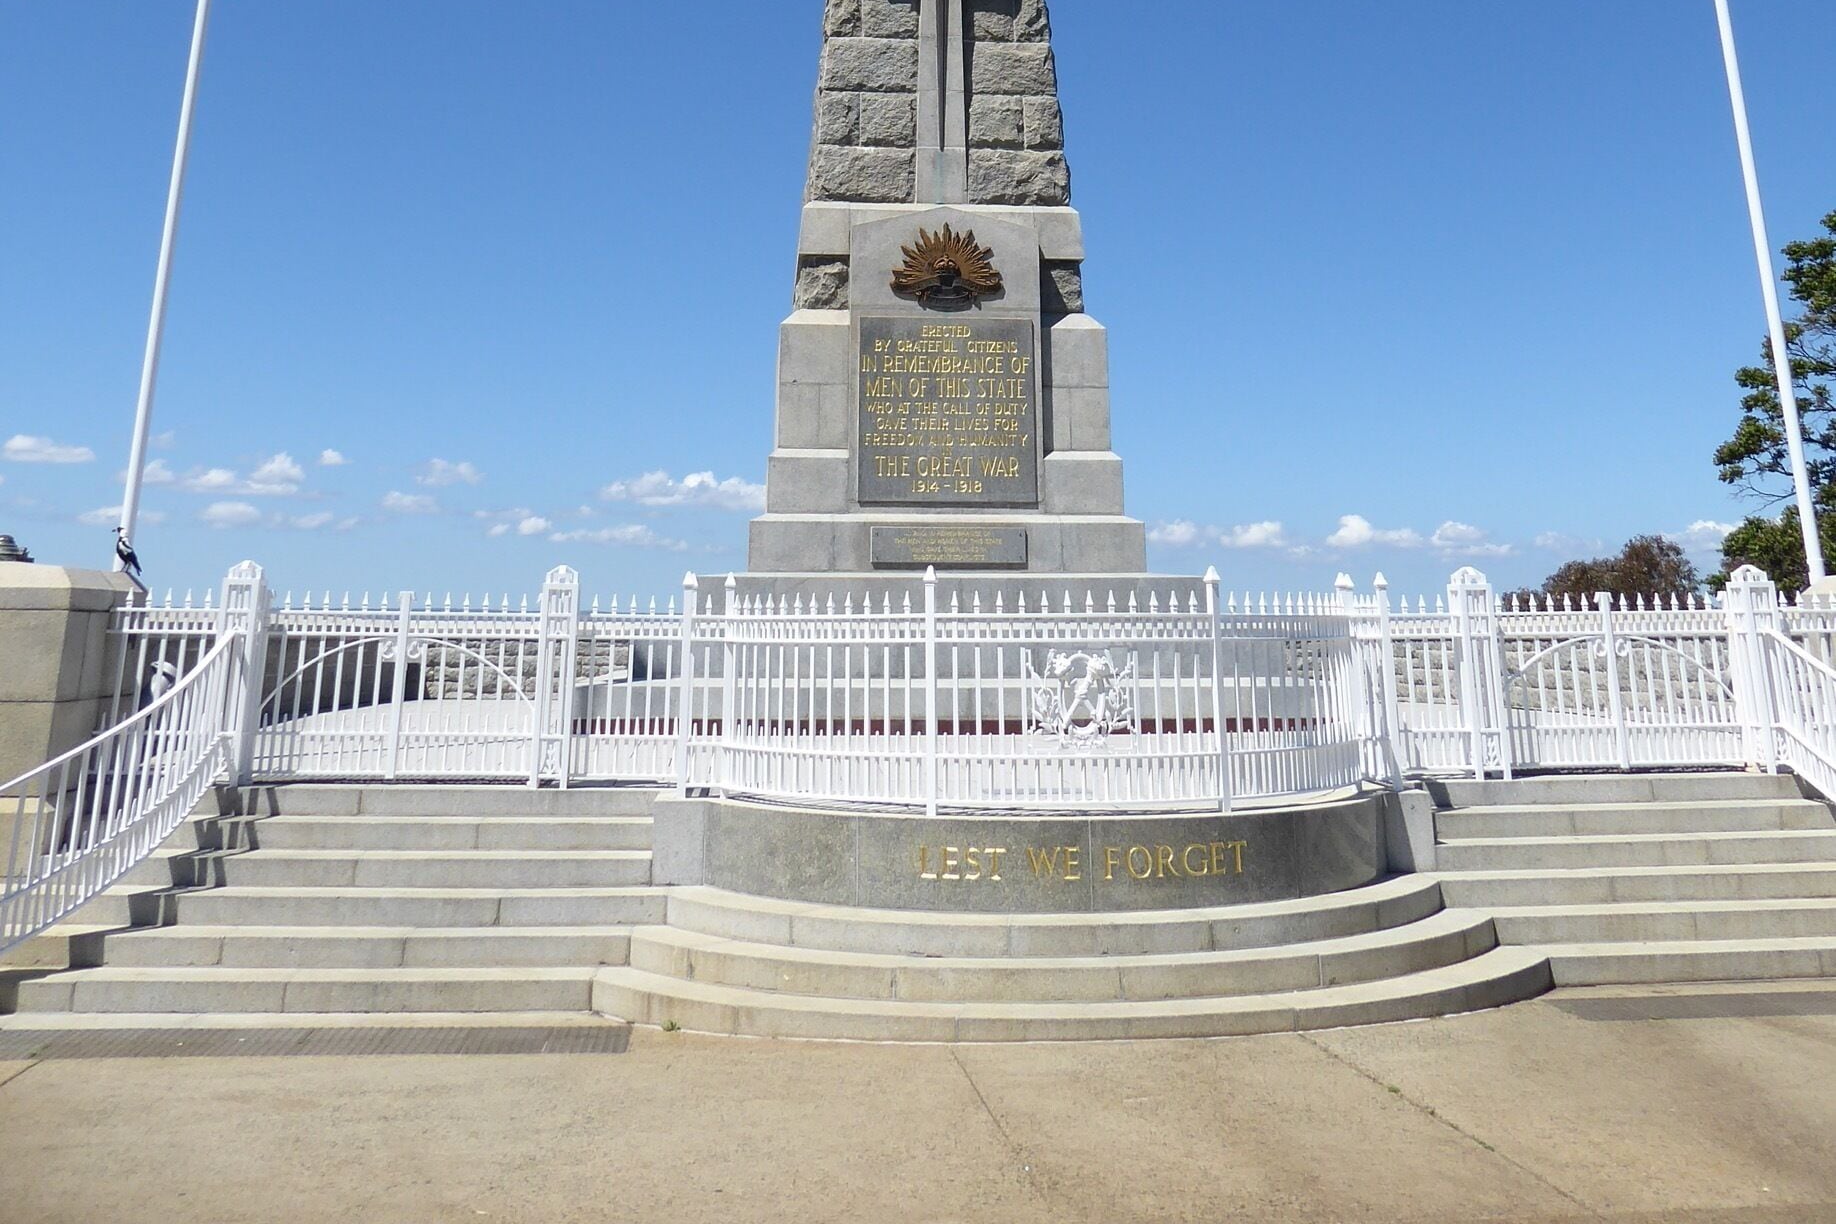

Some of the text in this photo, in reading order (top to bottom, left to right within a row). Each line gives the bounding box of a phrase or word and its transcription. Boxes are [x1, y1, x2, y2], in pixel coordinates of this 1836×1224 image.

[921, 325, 971, 337] ERECTED
[874, 339, 1018, 354] BY GRATEFUL CITIZENS
[862, 355, 1030, 374] IN REMEMBRANCE OF
[865, 377, 1027, 398] MEN OF THIS STATE
[865, 402, 1028, 415] WHO AT THE CALL OF DUTY
[876, 418, 1019, 431] GAVE THEIR LIVES FOR
[864, 433, 1028, 447] FREEDOM AND HUMANITY
[874, 456, 1020, 477] THE GREAT WAR
[911, 480, 940, 492] 1914
[954, 480, 982, 493] 1918
[919, 839, 1248, 881] LEST WE FORGET
